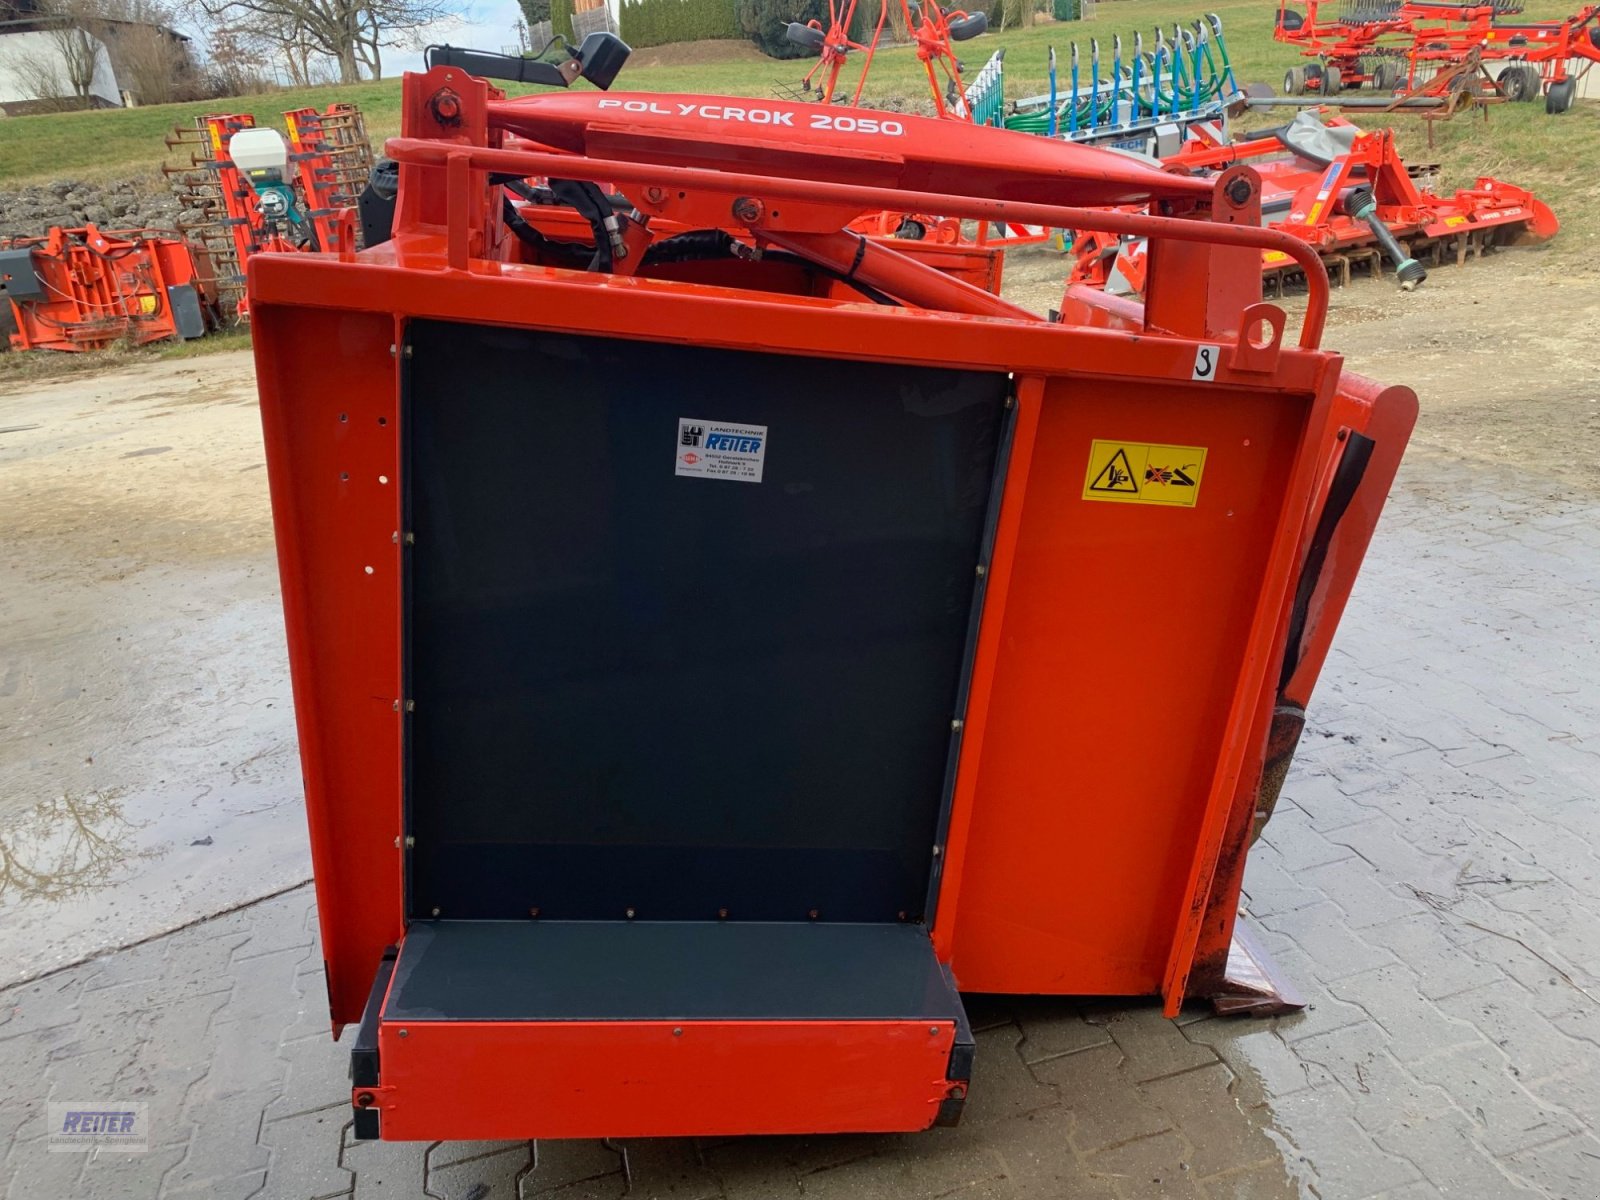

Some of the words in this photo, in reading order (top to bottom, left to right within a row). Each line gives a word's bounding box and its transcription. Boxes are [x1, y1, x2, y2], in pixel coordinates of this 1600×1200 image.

[598, 99, 794, 127] POLYCROK
[810, 114, 903, 136] 2050
[710, 427, 764, 436] LANDTECHNIK
[705, 433, 762, 453] REITER
